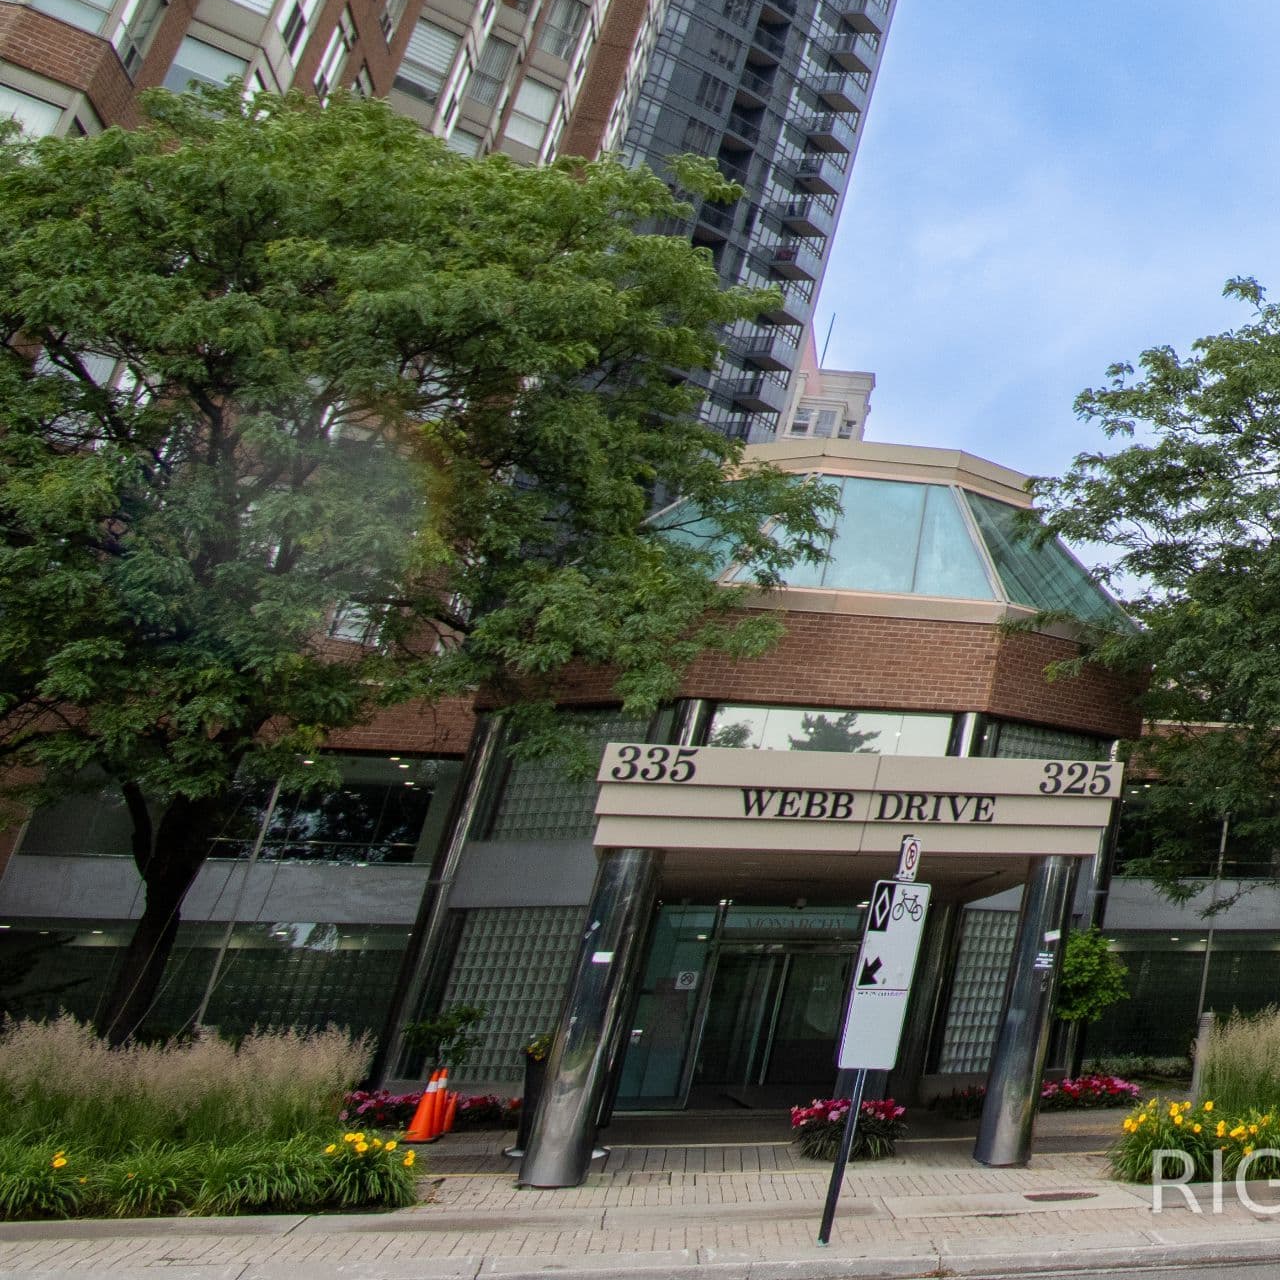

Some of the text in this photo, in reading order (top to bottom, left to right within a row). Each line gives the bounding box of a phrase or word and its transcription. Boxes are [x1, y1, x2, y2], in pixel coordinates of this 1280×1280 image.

[611, 745, 697, 781] 335
[1038, 762, 1111, 794] 325
[740, 788, 996, 822] WEBB DRIVE
